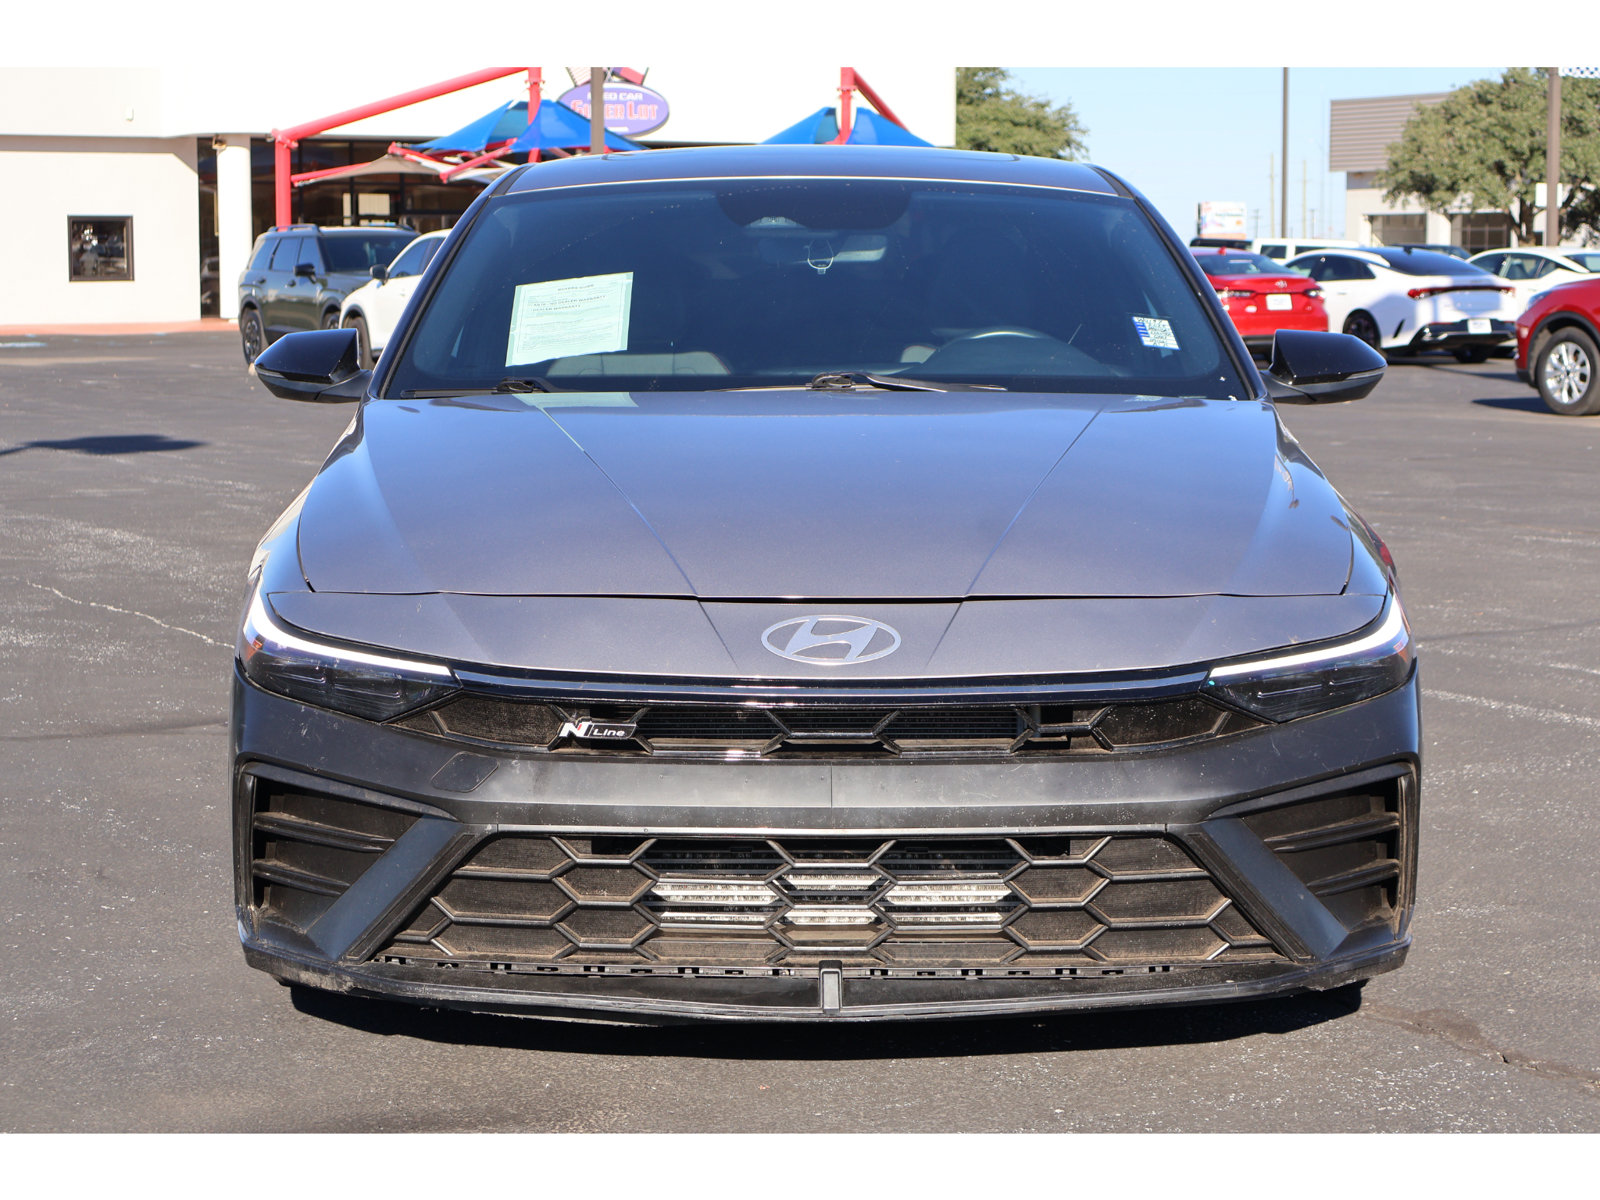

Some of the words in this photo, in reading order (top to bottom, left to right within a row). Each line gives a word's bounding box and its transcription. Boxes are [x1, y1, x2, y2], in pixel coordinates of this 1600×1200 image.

[619, 92, 643, 100] CAR
[559, 721, 590, 737] N
[593, 728, 625, 736] Line
